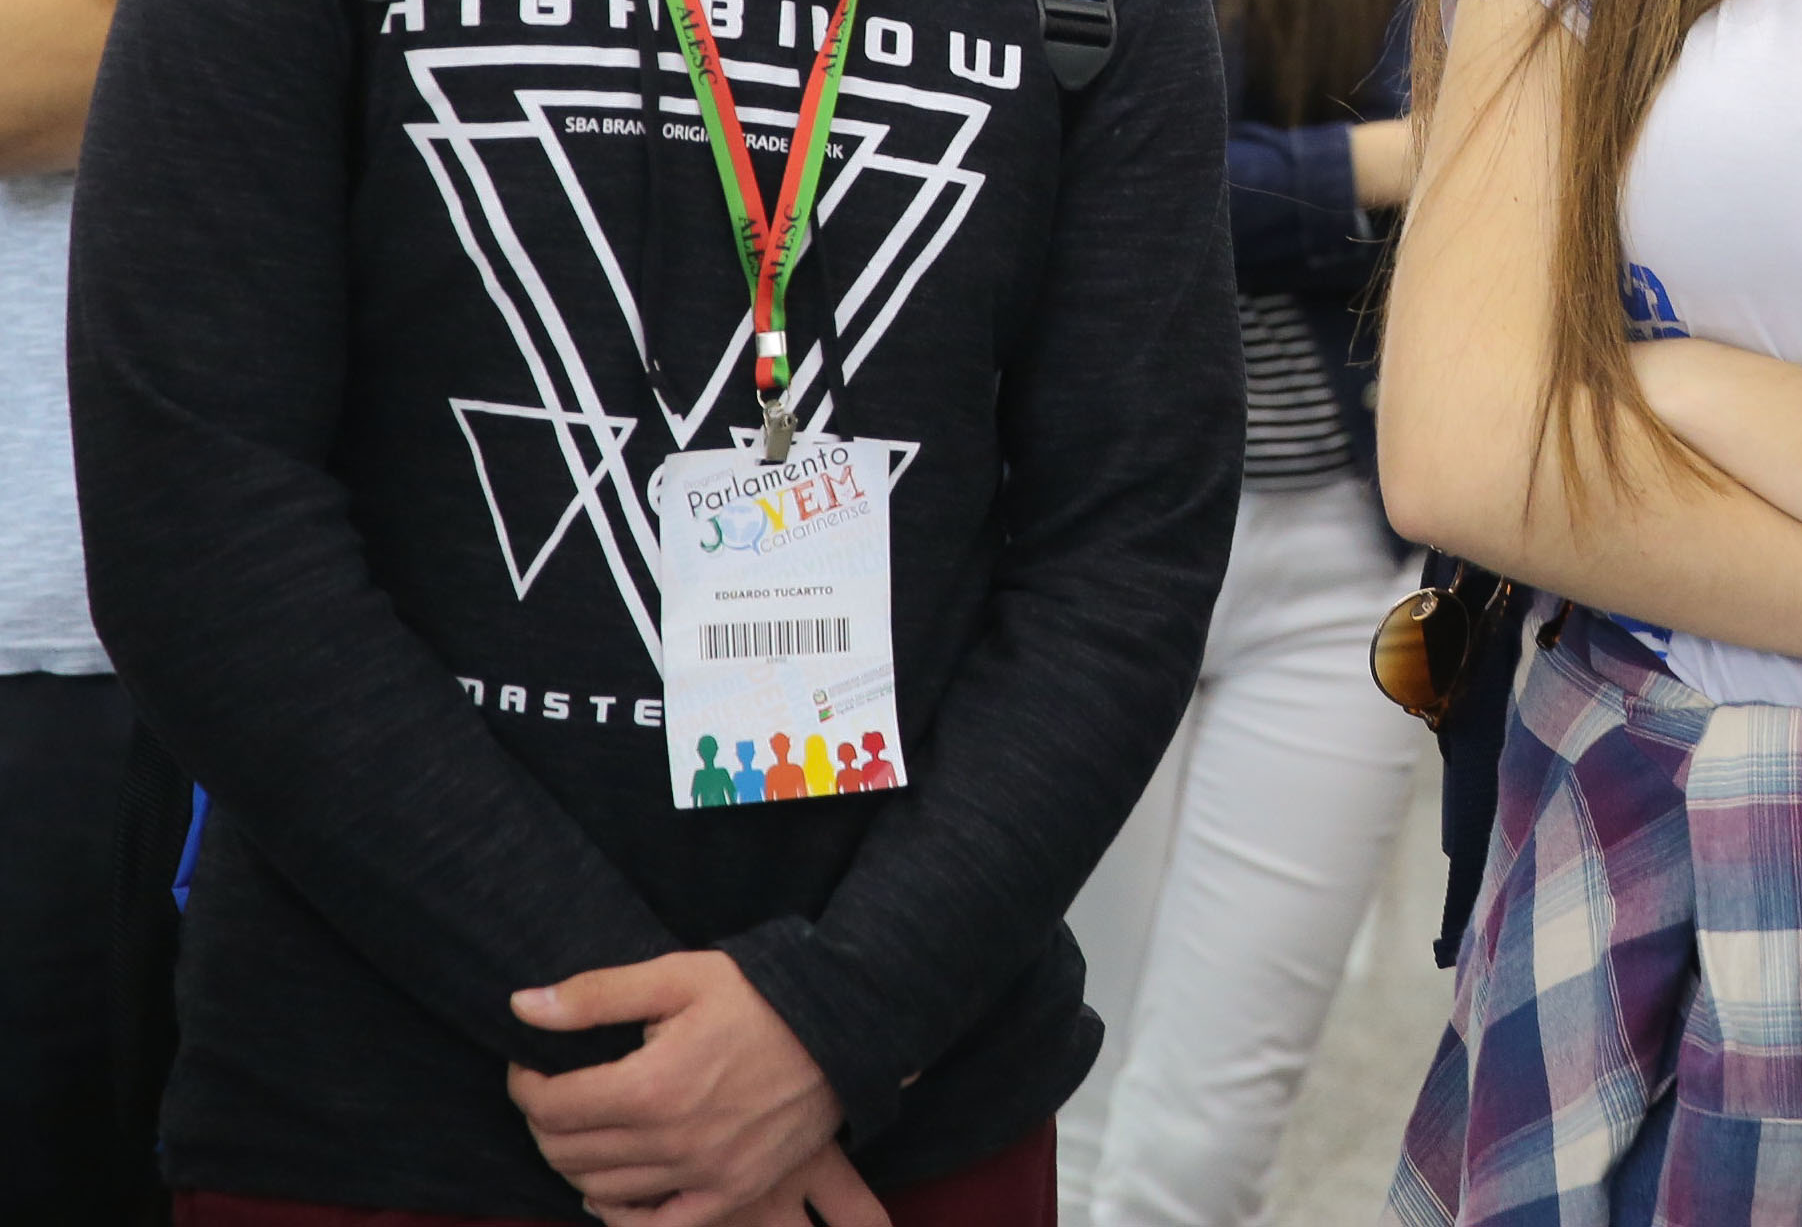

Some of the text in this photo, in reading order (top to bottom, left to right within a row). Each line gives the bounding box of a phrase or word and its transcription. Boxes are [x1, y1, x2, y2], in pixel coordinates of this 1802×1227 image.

[676, 4, 718, 87] ALESC
[565, 116, 599, 134] SBA
[602, 118, 646, 136] BRAN
[767, 203, 802, 286] ALESC
[687, 447, 849, 517] Parlamento
[759, 499, 872, 555] catarinense
[715, 586, 834, 601] EDUARDO TUCARTTO
